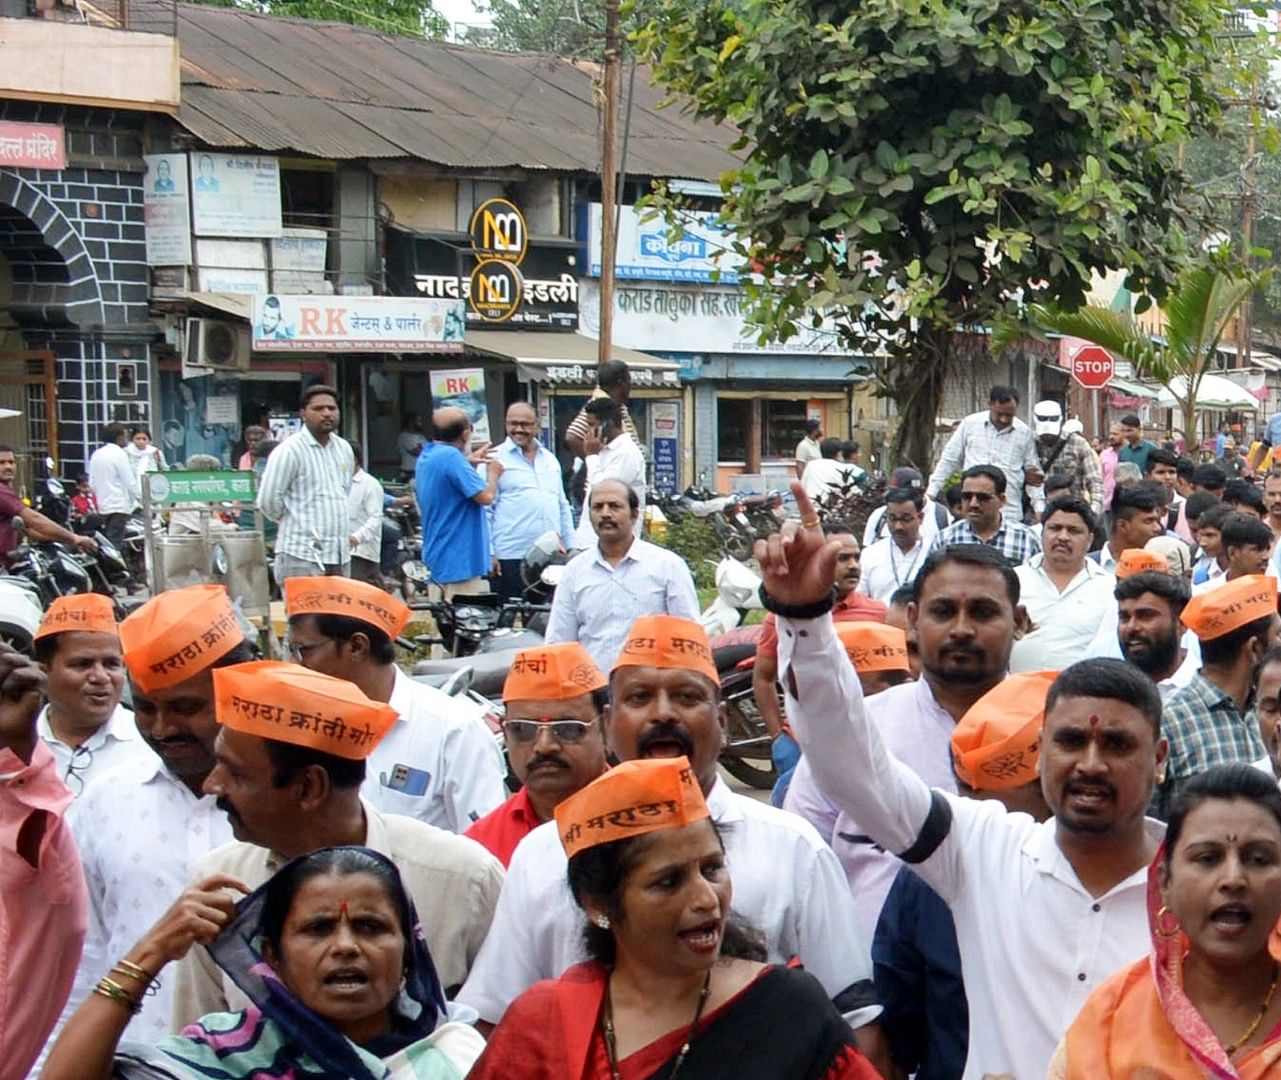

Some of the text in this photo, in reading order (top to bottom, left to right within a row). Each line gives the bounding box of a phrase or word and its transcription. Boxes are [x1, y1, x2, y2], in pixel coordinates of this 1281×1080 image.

[523, 273, 579, 303] इडली
[618, 289, 651, 316] कराड
[300, 306, 349, 336] RK
[384, 317, 393, 331] &
[1075, 361, 1111, 373] STOP
[446, 378, 469, 393] RK
[232, 695, 285, 724] मराठा
[287, 709, 346, 741] क्रांती
[585, 799, 678, 828] मराठा
